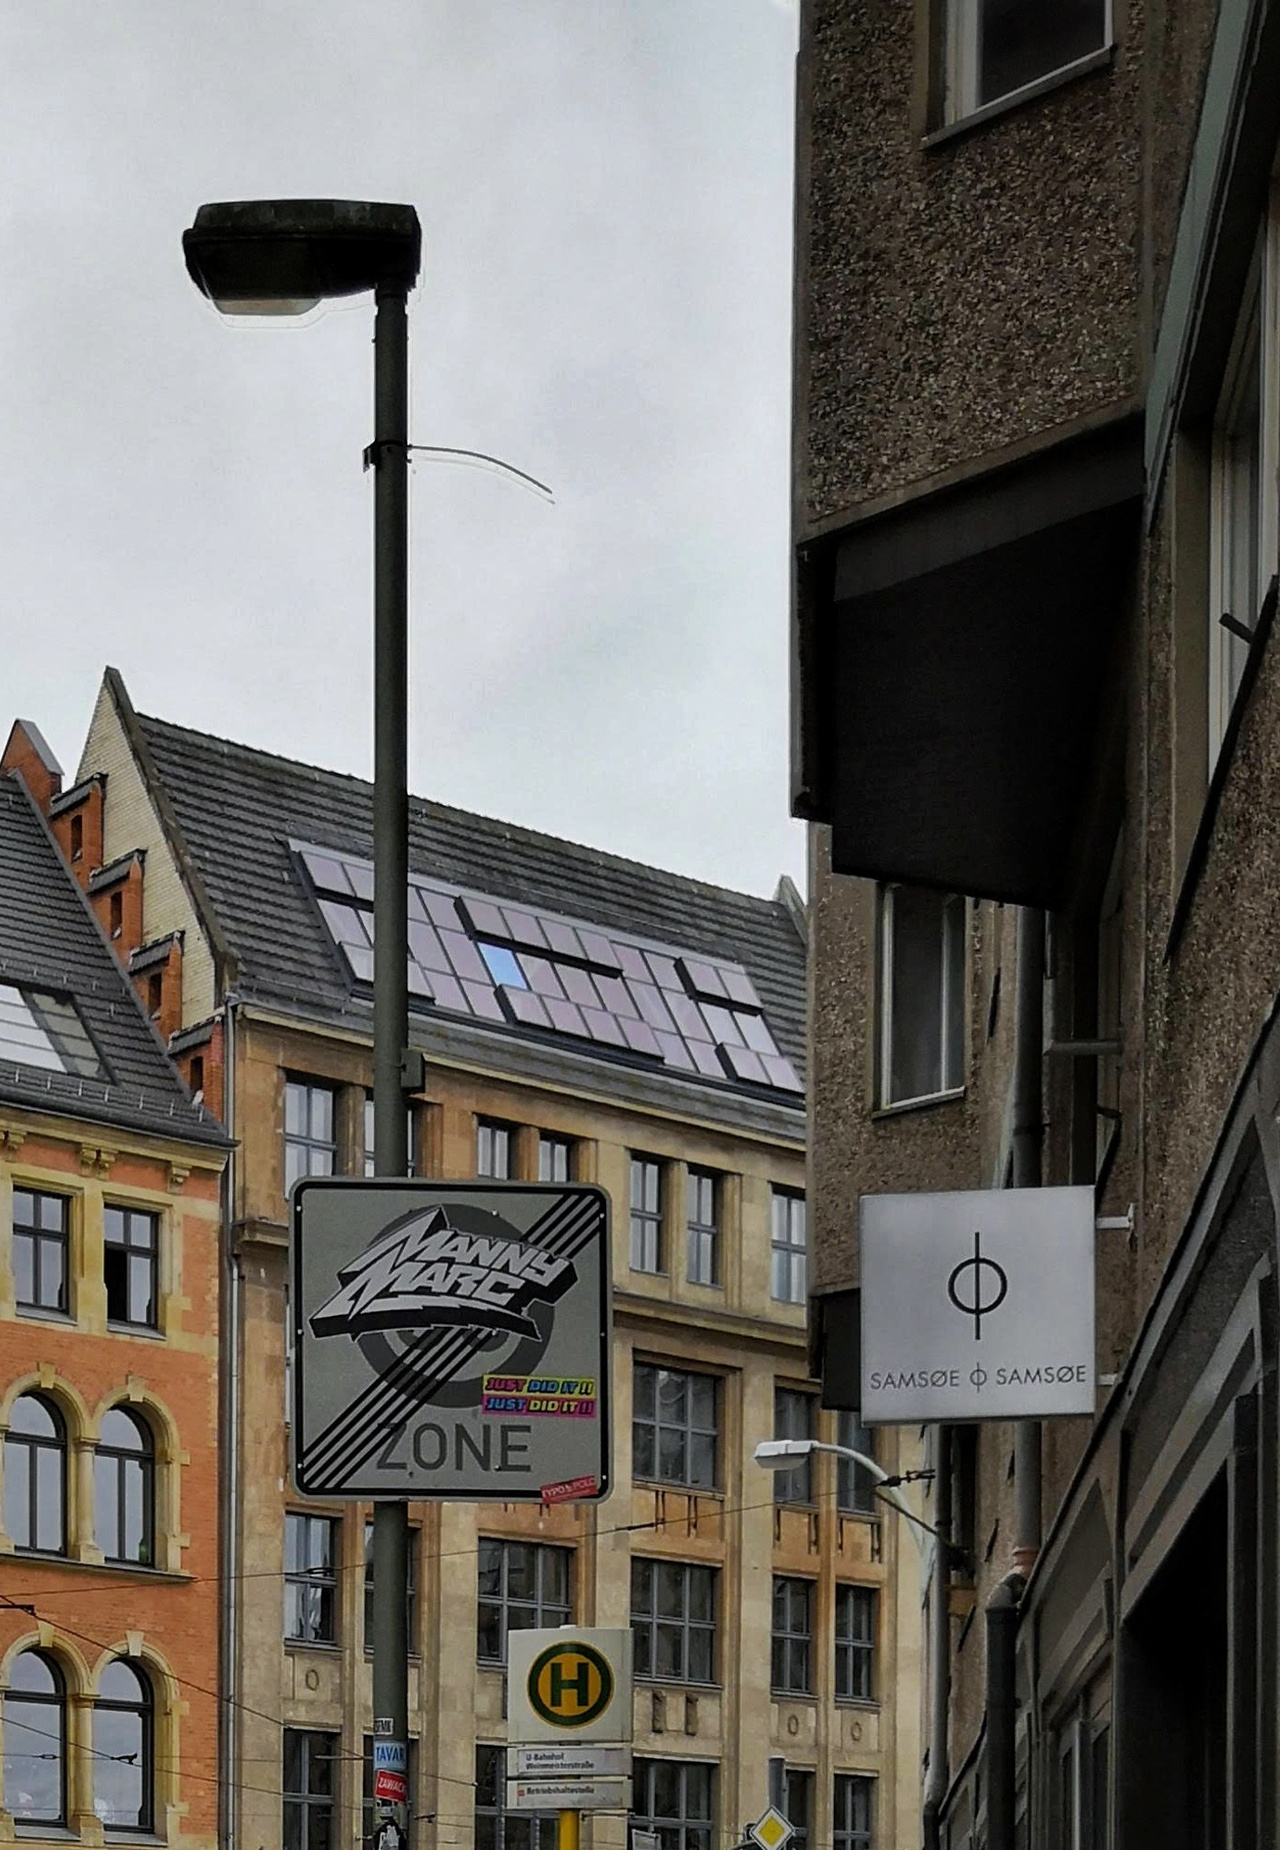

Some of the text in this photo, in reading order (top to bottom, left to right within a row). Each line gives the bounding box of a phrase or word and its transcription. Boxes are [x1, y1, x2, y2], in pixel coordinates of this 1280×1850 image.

[337, 1207, 570, 1287] MANNY
[311, 1243, 526, 1321] MARC
[485, 1378, 526, 1392] JUST
[527, 1379, 560, 1393] DID
[561, 1381, 579, 1394] IT
[870, 1365, 1087, 1390] SAMSØE SAMSØE
[486, 1397, 527, 1411] JUST
[528, 1399, 560, 1413] DID
[561, 1401, 579, 1413] IT
[376, 1421, 532, 1472] ZONE
[549, 1662, 590, 1707] H
